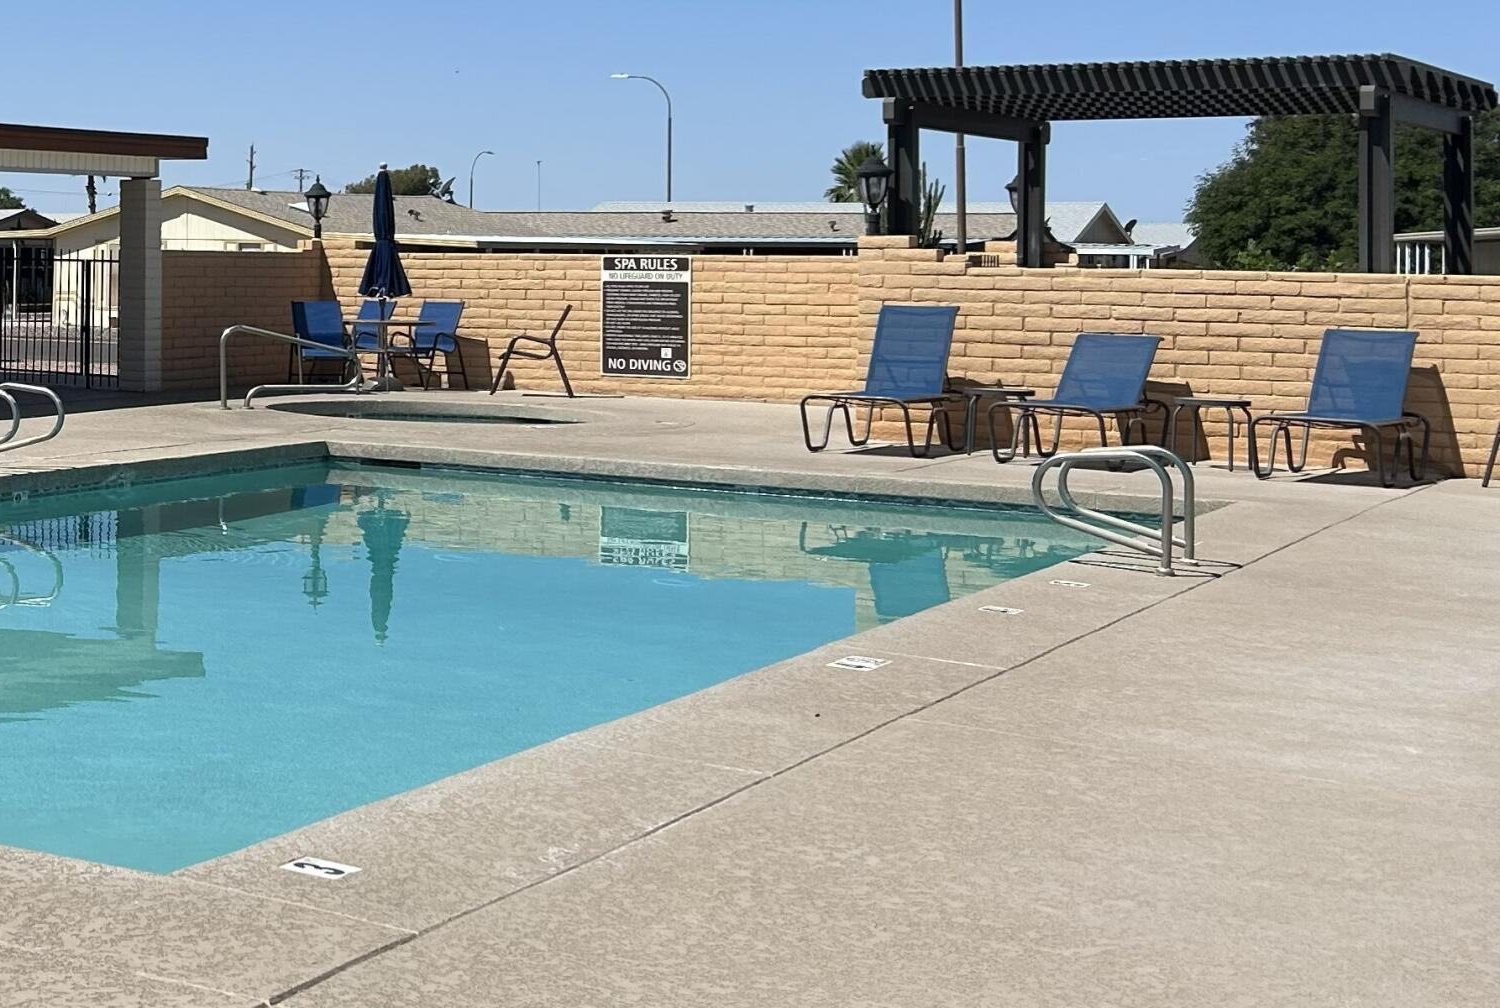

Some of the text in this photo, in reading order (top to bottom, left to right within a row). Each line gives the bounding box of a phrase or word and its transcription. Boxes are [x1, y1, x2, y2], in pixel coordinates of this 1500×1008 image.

[614, 258, 678, 270] SPA RULES
[608, 358, 671, 371] NO DIVING
